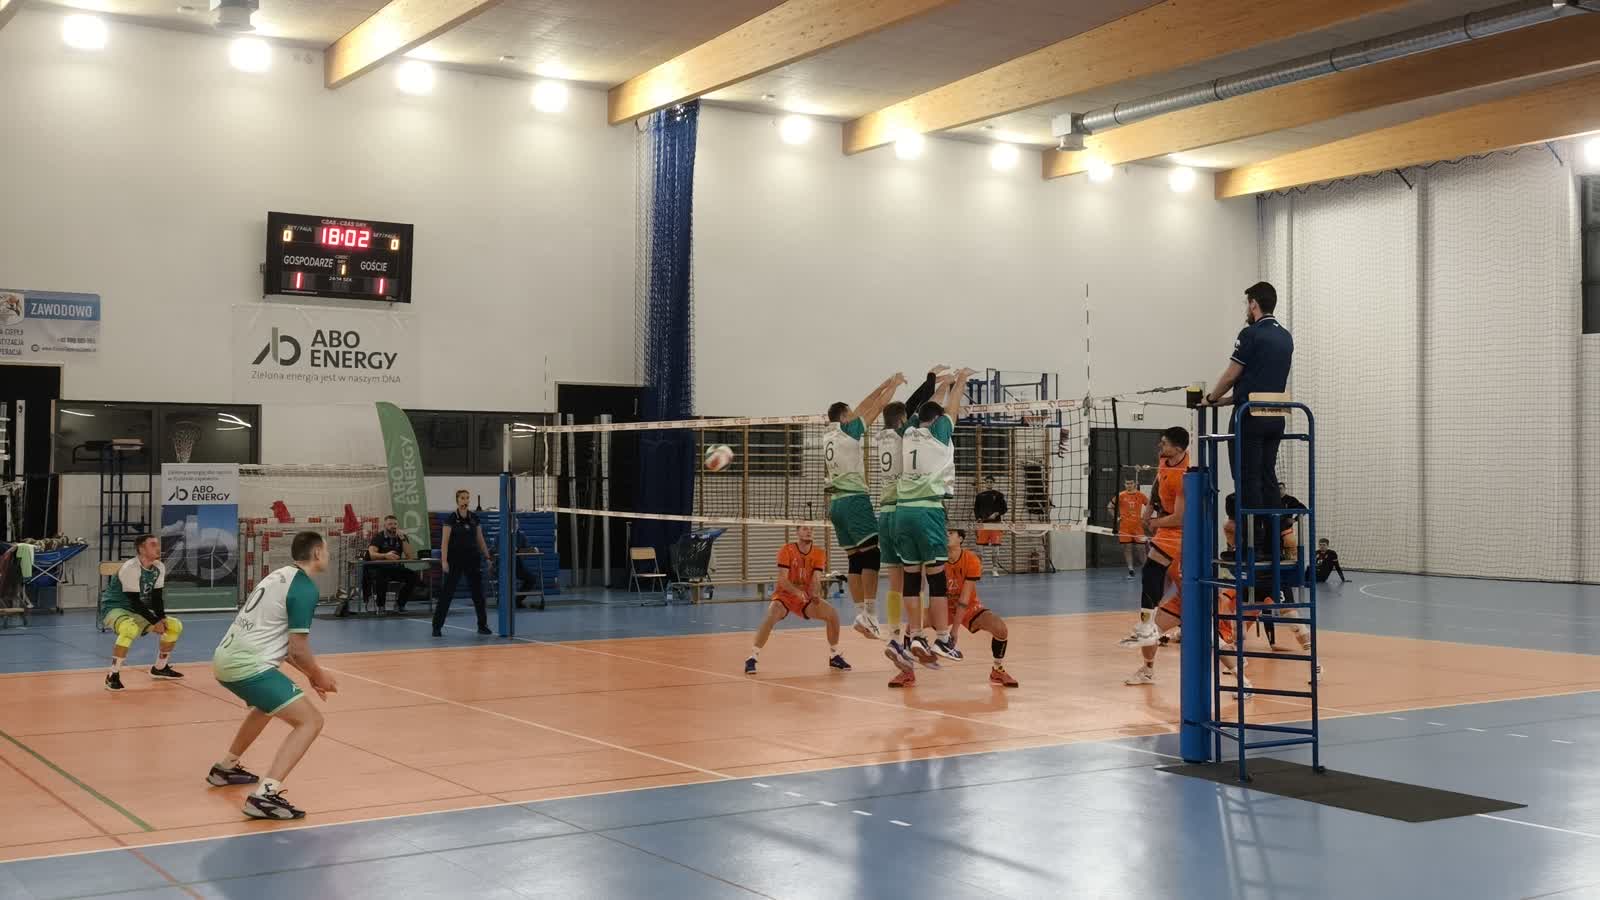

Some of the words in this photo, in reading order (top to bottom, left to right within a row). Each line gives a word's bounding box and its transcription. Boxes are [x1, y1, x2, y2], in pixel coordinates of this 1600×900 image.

[283, 229, 292, 242] 0
[390, 239, 399, 250] 0
[283, 255, 334, 268] GOSPODARZE
[360, 260, 388, 272] GOŚCIE
[341, 264, 346, 275] 1
[296, 272, 301, 289] 1
[378, 278, 384, 294] 1
[30, 303, 92, 318] ZAWODOWO
[310, 329, 360, 348] ABO
[310, 350, 398, 369] ENERGY
[251, 370, 284, 380] Zielona
[286, 373, 319, 383] energia
[320, 374, 337, 384] jest
[349, 375, 380, 384] naszym
[382, 375, 401, 383] DNA
[825, 441, 834, 461] 6
[881, 451, 892, 473] 9
[909, 449, 918, 470] 1
[401, 435, 419, 505] ENERGY
[192, 485, 214, 493] ABO
[391, 466, 405, 505] ABO
[191, 493, 230, 501] ENERGY
